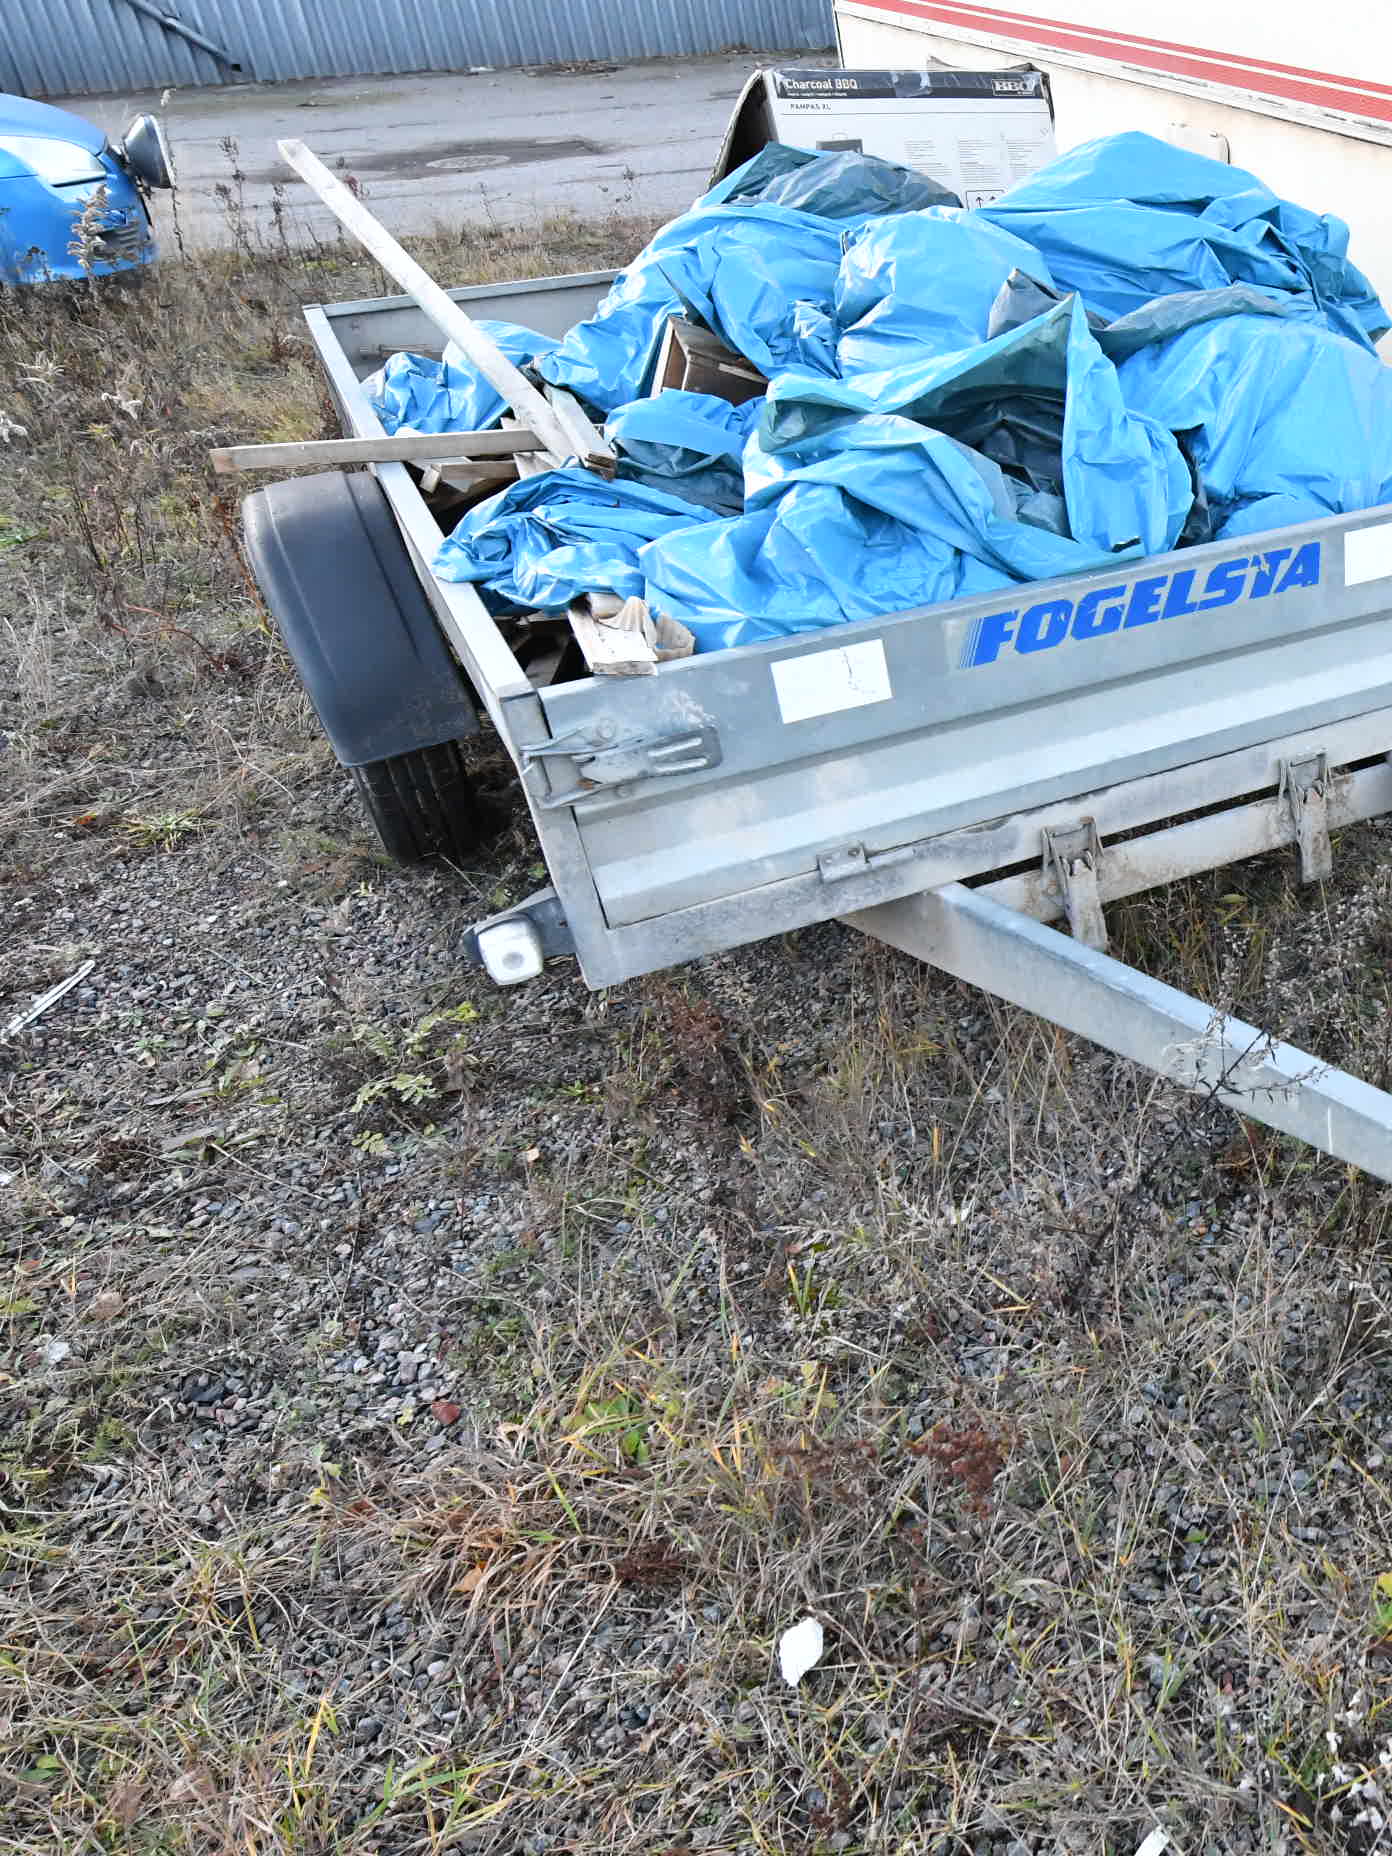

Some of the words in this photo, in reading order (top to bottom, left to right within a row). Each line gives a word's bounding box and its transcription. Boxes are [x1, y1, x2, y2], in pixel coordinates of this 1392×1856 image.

[784, 78, 832, 90] Charcoal
[834, 78, 858, 90] BBQ
[968, 541, 1321, 668] FOGELSTA
